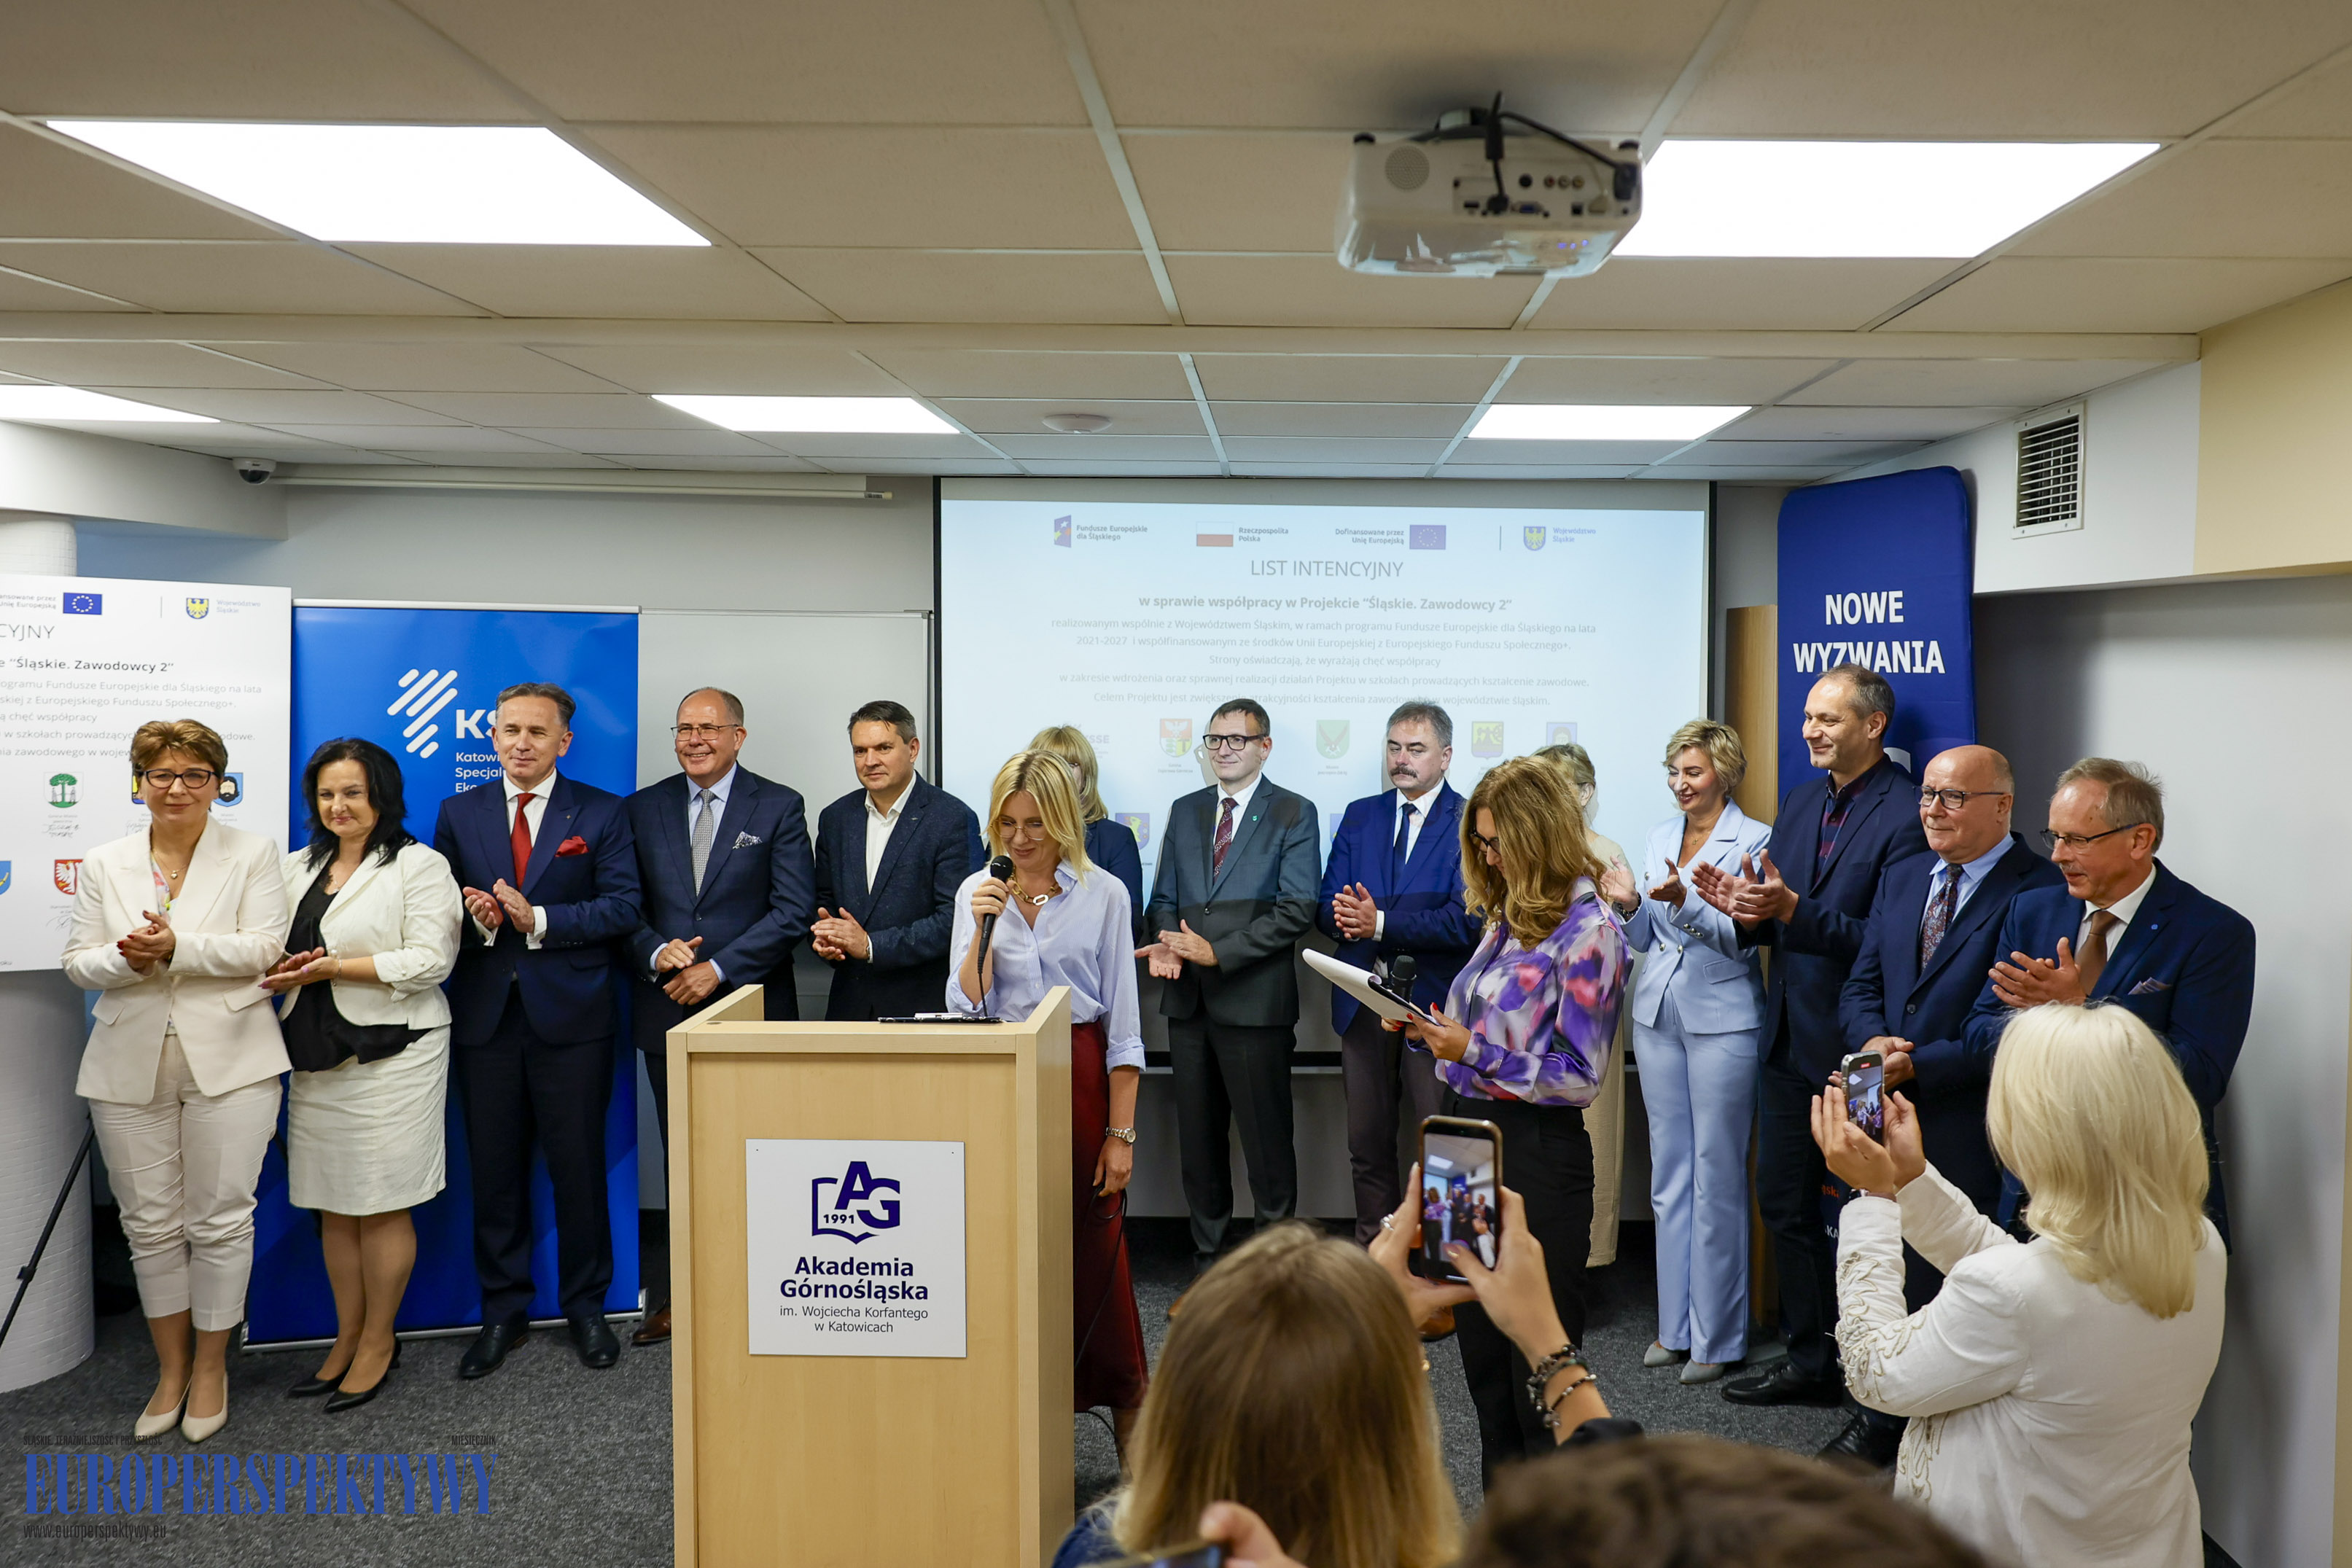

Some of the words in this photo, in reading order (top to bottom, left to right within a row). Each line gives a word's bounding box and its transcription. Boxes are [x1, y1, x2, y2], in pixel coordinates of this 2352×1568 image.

[1110, 525, 1148, 533] Europejskie
[1239, 527, 1288, 535] Rzeczpospolita
[1553, 527, 1597, 535] Województwo
[1089, 532, 1121, 541] Śląskiego
[1368, 537, 1404, 545] Europejską
[1553, 535, 1575, 544] Śląskie
[1251, 560, 1288, 576] LIST
[1293, 561, 1403, 580] INTENCYJNY
[16, 601, 57, 609] Europejską
[1139, 598, 1150, 606] w
[1153, 596, 1204, 609] sprawie
[1208, 596, 1282, 611] współpracy
[1285, 598, 1297, 607] w
[1300, 597, 1360, 611] Projekcie
[1420, 598, 1495, 613] Zawodowcy
[1825, 590, 1904, 625] NOWE
[1051, 619, 1119, 630] realizowanym
[1121, 619, 1164, 630] wspólnie
[1175, 620, 1251, 631] Województwem
[1254, 620, 1293, 631] Śląskim,
[1306, 621, 1342, 631] ramach
[1344, 623, 1393, 633] programu
[1395, 621, 1441, 631] Fundusze
[1443, 623, 1498, 634] Europejskie
[1500, 623, 1515, 633] dla
[1517, 622, 1562, 634] Śląskiego
[1564, 625, 1576, 633] na
[1578, 624, 1597, 633] lata
[1076, 636, 1127, 646] 2021-2027
[1138, 636, 1237, 649] współfinansowanym
[1253, 637, 1293, 647] środków
[1296, 638, 1315, 647] Unii
[1318, 639, 1376, 650] Europejskiej
[1385, 639, 1452, 650] Europejskiego
[1455, 640, 1500, 650] Funduszu
[1209, 655, 1241, 666] Strony
[1243, 655, 1303, 666] oświadczają,
[1305, 656, 1316, 665] że
[1318, 656, 1360, 668] wyrażają
[1362, 657, 1385, 668] chęć
[1387, 657, 1441, 668] współpracy
[1792, 640, 1946, 674] WYZWANIA
[74, 660, 156, 674] Zawodowcy
[46, 679, 97, 690] Fundusze
[99, 681, 160, 693] Europejskie
[162, 682, 177, 692] dla
[180, 682, 226, 694] Śląskiego
[244, 685, 262, 694] lata
[1070, 674, 1110, 682] zakresie
[1113, 674, 1163, 683] wdrożenia
[1189, 675, 1234, 685] sprawnej
[1235, 674, 1277, 685] realizacji
[1279, 674, 1313, 684] działań
[1316, 675, 1356, 686] Projektu
[1369, 675, 1409, 685] szkołach
[1411, 676, 1480, 687] prowadzących
[1482, 676, 1534, 687] kształcenie
[1536, 677, 1589, 687] zawodowe.
[36, 695, 109, 707] Europejskiego
[113, 697, 162, 706] Funduszu
[1094, 693, 1124, 702] Celem
[1127, 693, 1167, 703] Projektu
[1169, 694, 1187, 704] jest
[1314, 694, 1365, 704] kształcenia
[1444, 695, 1510, 706] województwie
[1512, 696, 1551, 707] śląskim.
[9, 712, 34, 722] chęć
[37, 712, 98, 723] współpracy
[16, 730, 63, 739] szkołach
[15, 748, 85, 758] zawodowego
[455, 767, 502, 780] Specjal
[823, 1214, 854, 1225] 1991
[1825, 1225, 1839, 1238] KA
[794, 1256, 914, 1276] Akademia
[780, 1278, 928, 1303] Górnośląska
[780, 1306, 798, 1317] im.
[802, 1306, 860, 1319] Wojciecha
[865, 1307, 928, 1321] Korfantego
[814, 1323, 824, 1331] w
[828, 1321, 893, 1333] Katowicach
